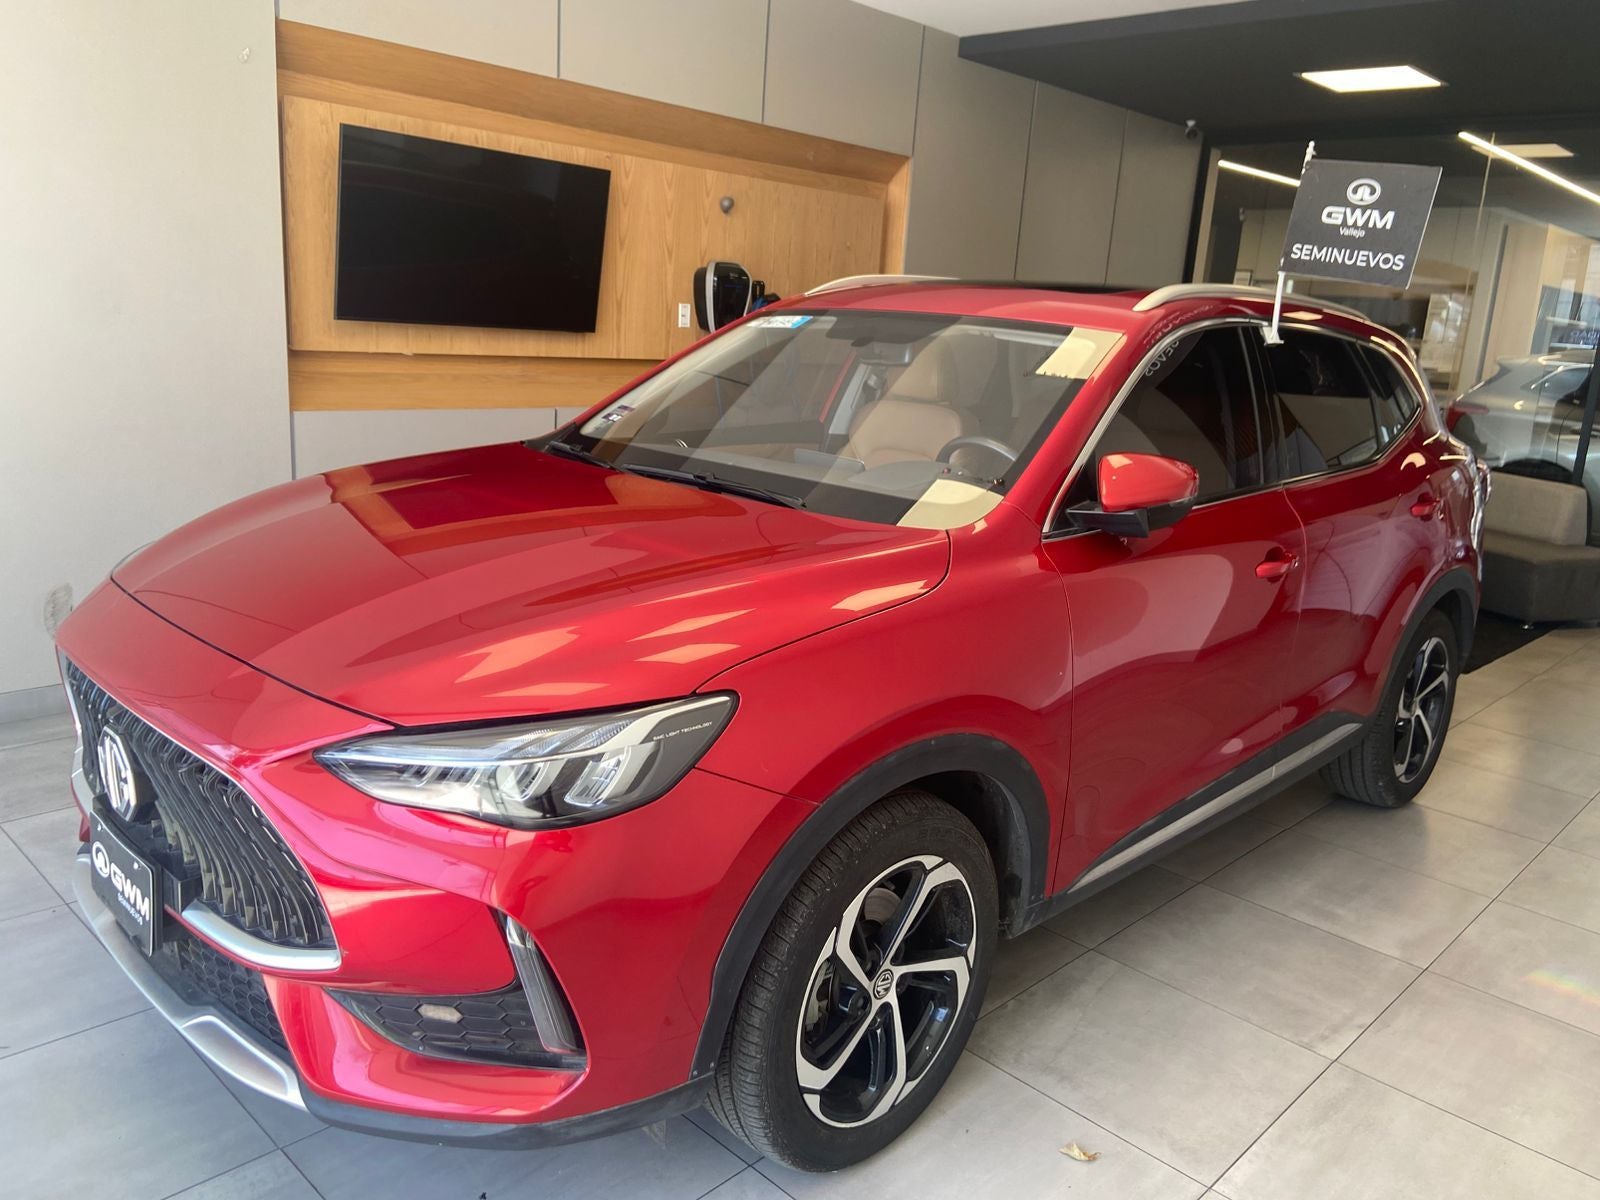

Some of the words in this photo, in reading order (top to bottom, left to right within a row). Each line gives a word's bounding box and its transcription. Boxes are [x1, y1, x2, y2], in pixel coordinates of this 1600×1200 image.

[1321, 205, 1396, 230] GWM
[1339, 227, 1365, 238] Vallejo
[1290, 243, 1406, 271] SEMINUEVOS
[681, 721, 712, 733] TECHNOLOGY
[110, 862, 149, 921] GWM
